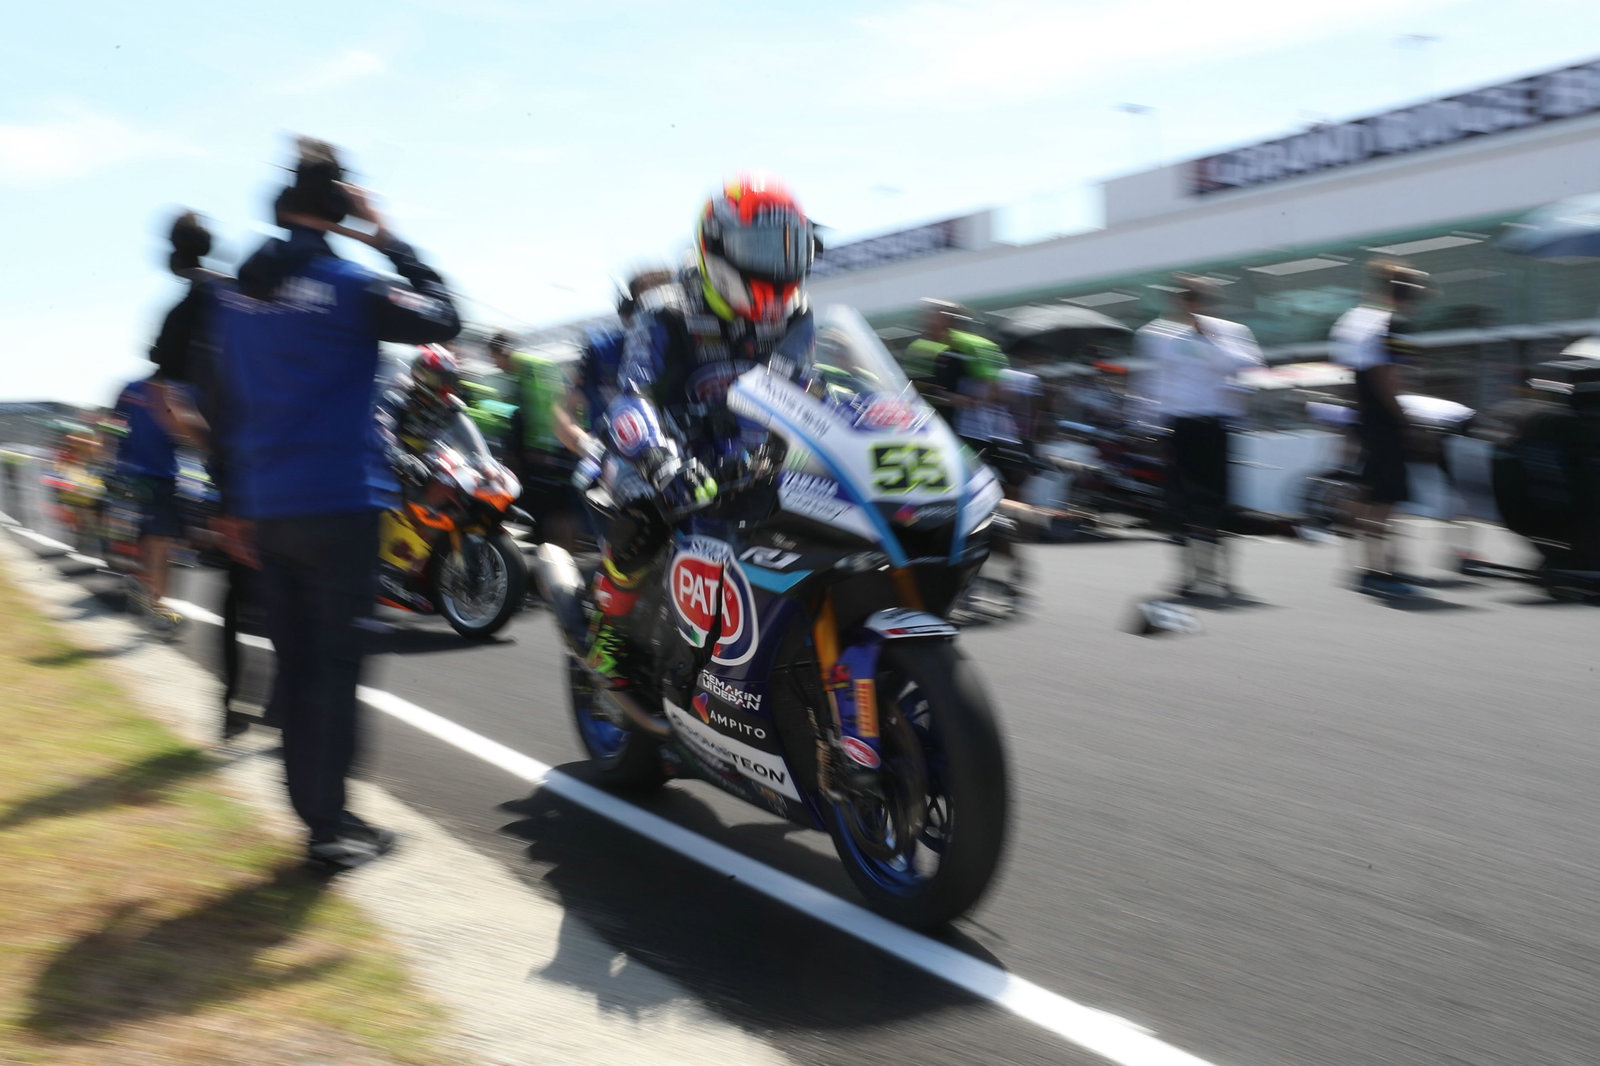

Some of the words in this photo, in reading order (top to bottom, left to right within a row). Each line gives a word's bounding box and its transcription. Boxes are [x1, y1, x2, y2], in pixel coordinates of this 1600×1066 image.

[870, 443, 952, 494] 55
[679, 566, 731, 627] PATA
[710, 710, 767, 739] AMPITO
